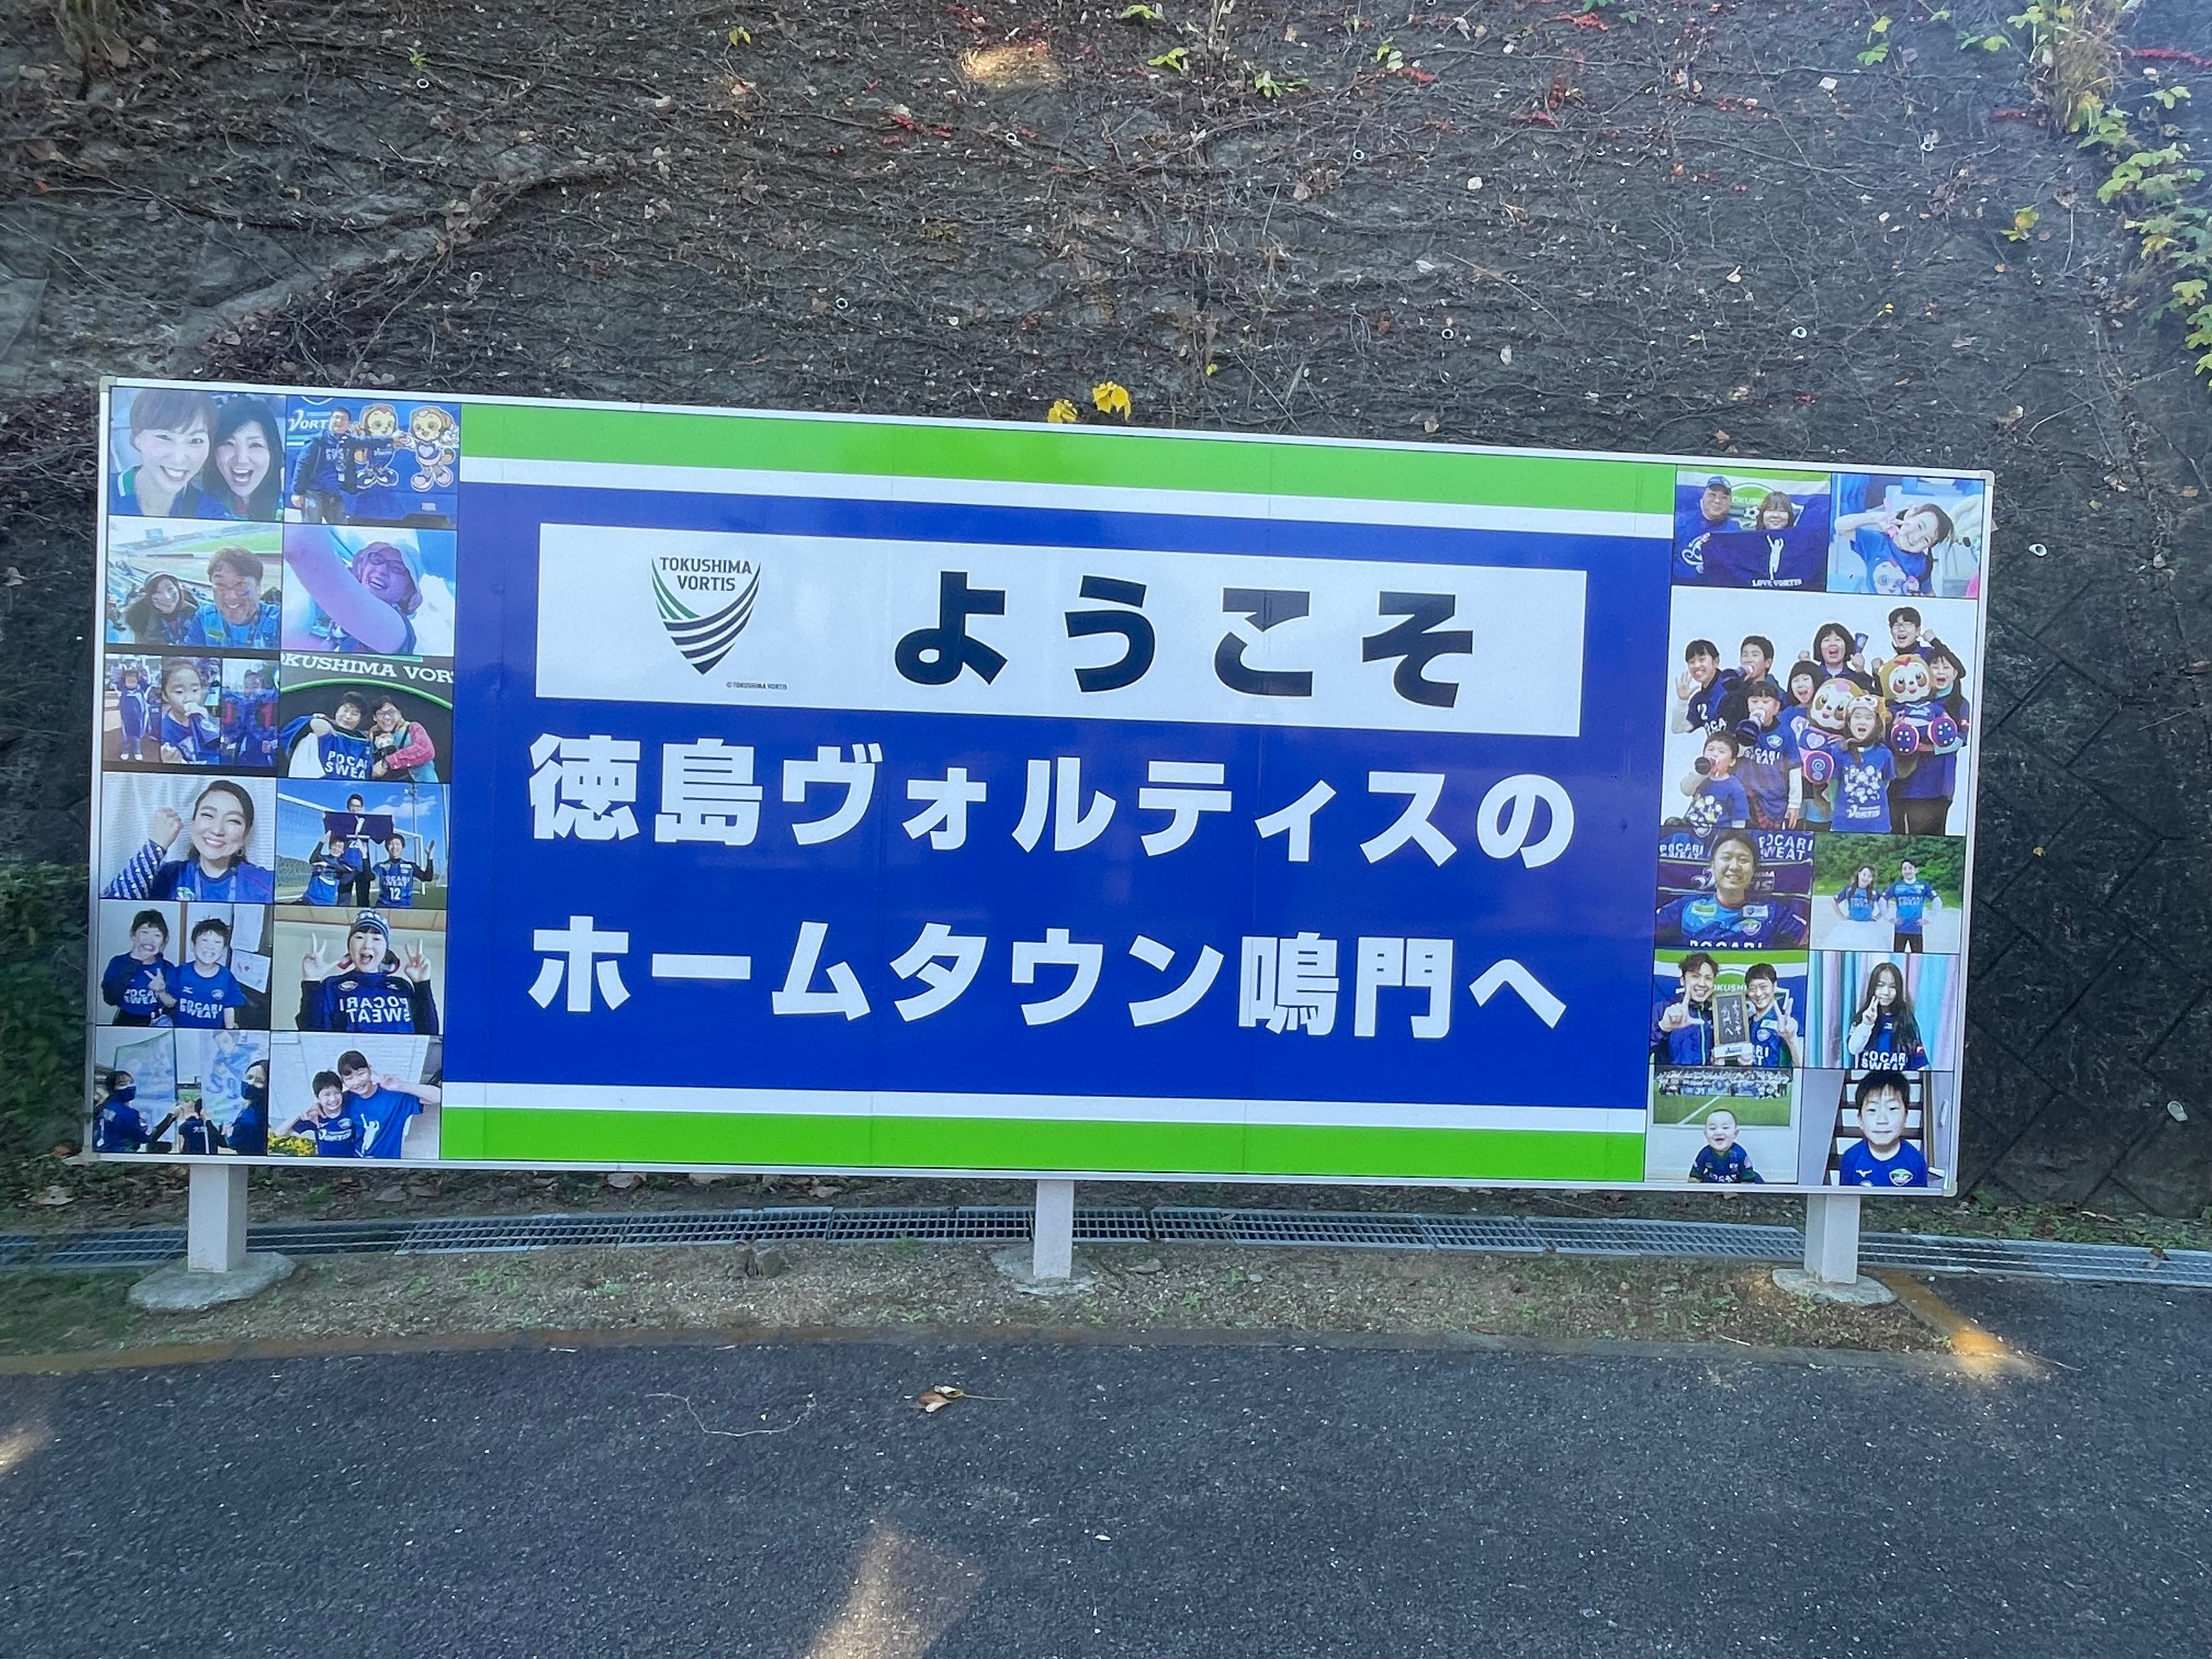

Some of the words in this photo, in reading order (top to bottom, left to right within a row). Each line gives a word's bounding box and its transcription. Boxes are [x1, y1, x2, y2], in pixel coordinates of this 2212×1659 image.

[660, 556, 752, 574] TOKUSHIMA
[677, 575, 736, 591] VORTIS
[895, 571, 1472, 707] ようこそ
[403, 666, 453, 683] VOR
[529, 734, 1574, 868] 徳島ヴォルティスの
[389, 887, 401, 900] 12
[528, 916, 1566, 1037] ホームタウン鳴門へ
